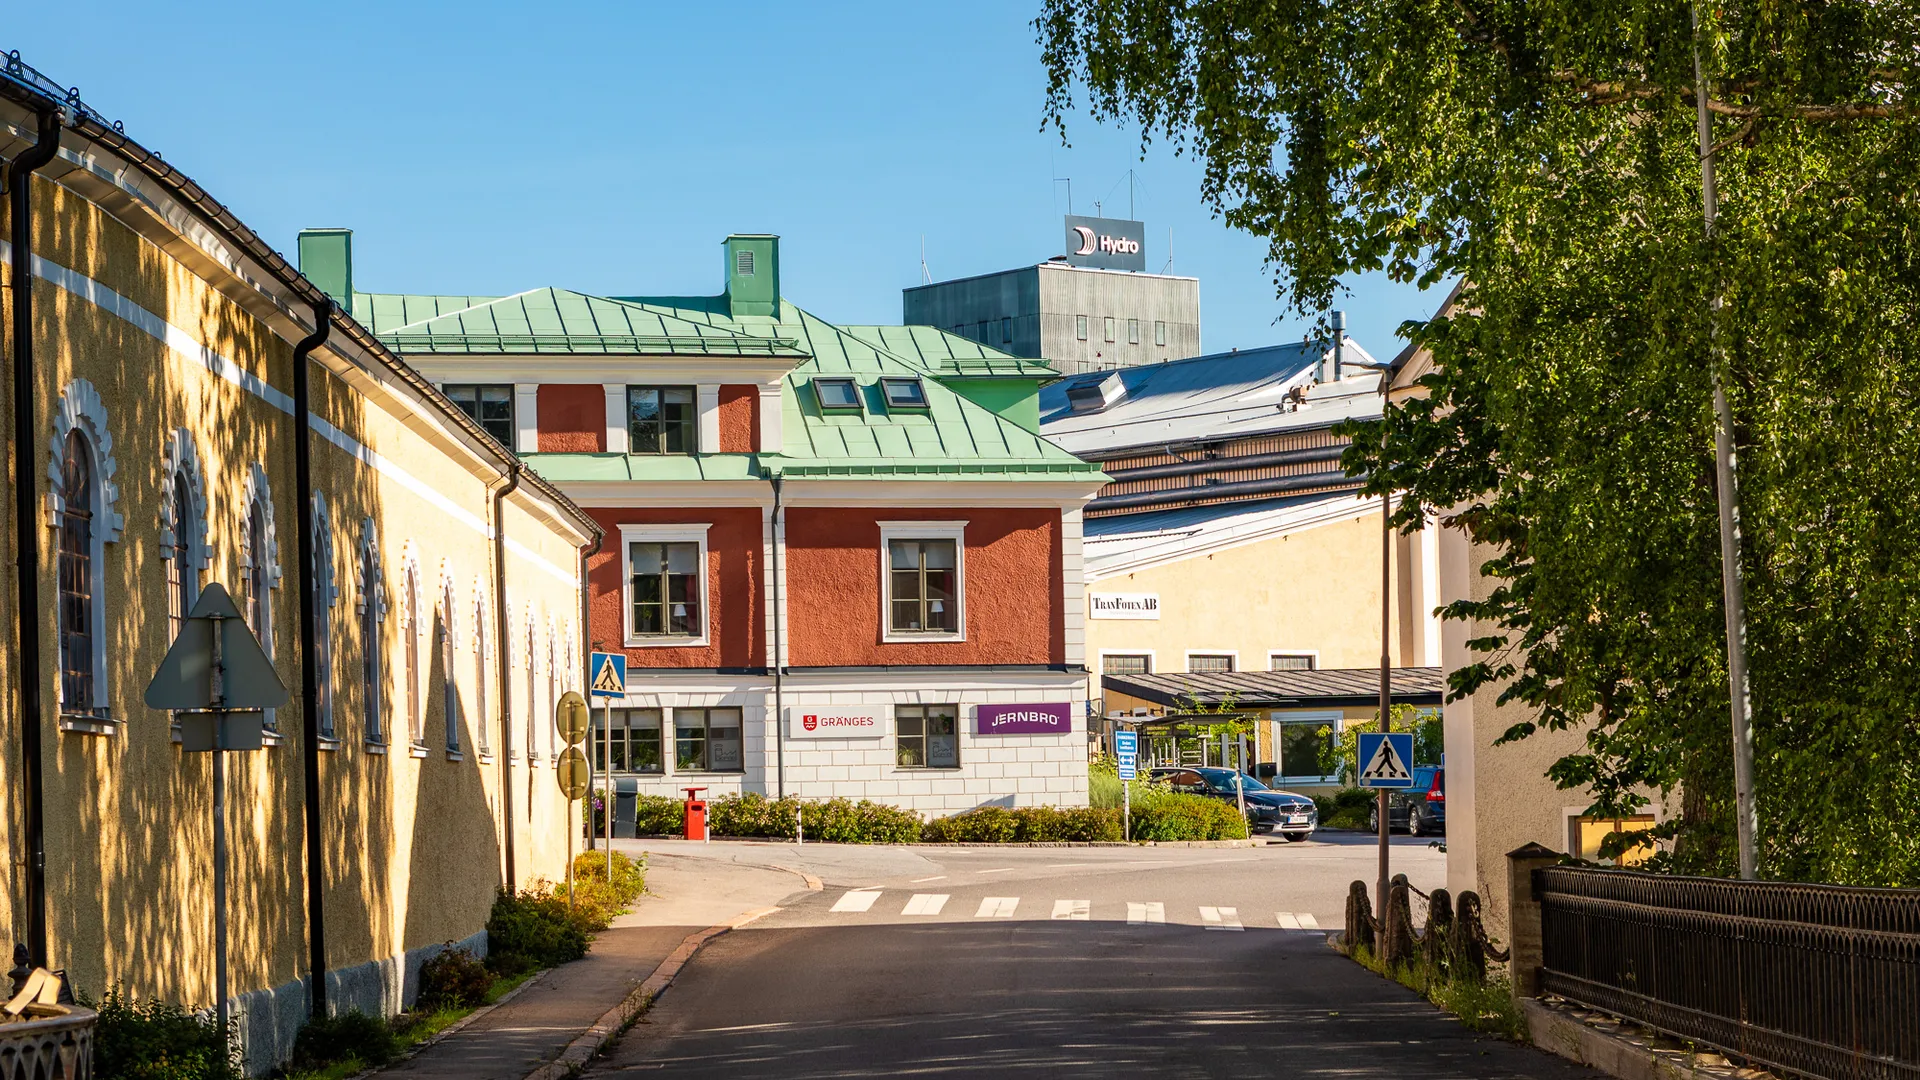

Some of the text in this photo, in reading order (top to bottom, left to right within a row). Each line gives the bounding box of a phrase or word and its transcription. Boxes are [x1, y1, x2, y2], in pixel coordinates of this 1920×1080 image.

[1100, 235, 1139, 255] Hydro
[1142, 598, 1157, 610] AB
[820, 716, 874, 727] GRÄNGES
[992, 711, 1058, 727] JERNBRO
